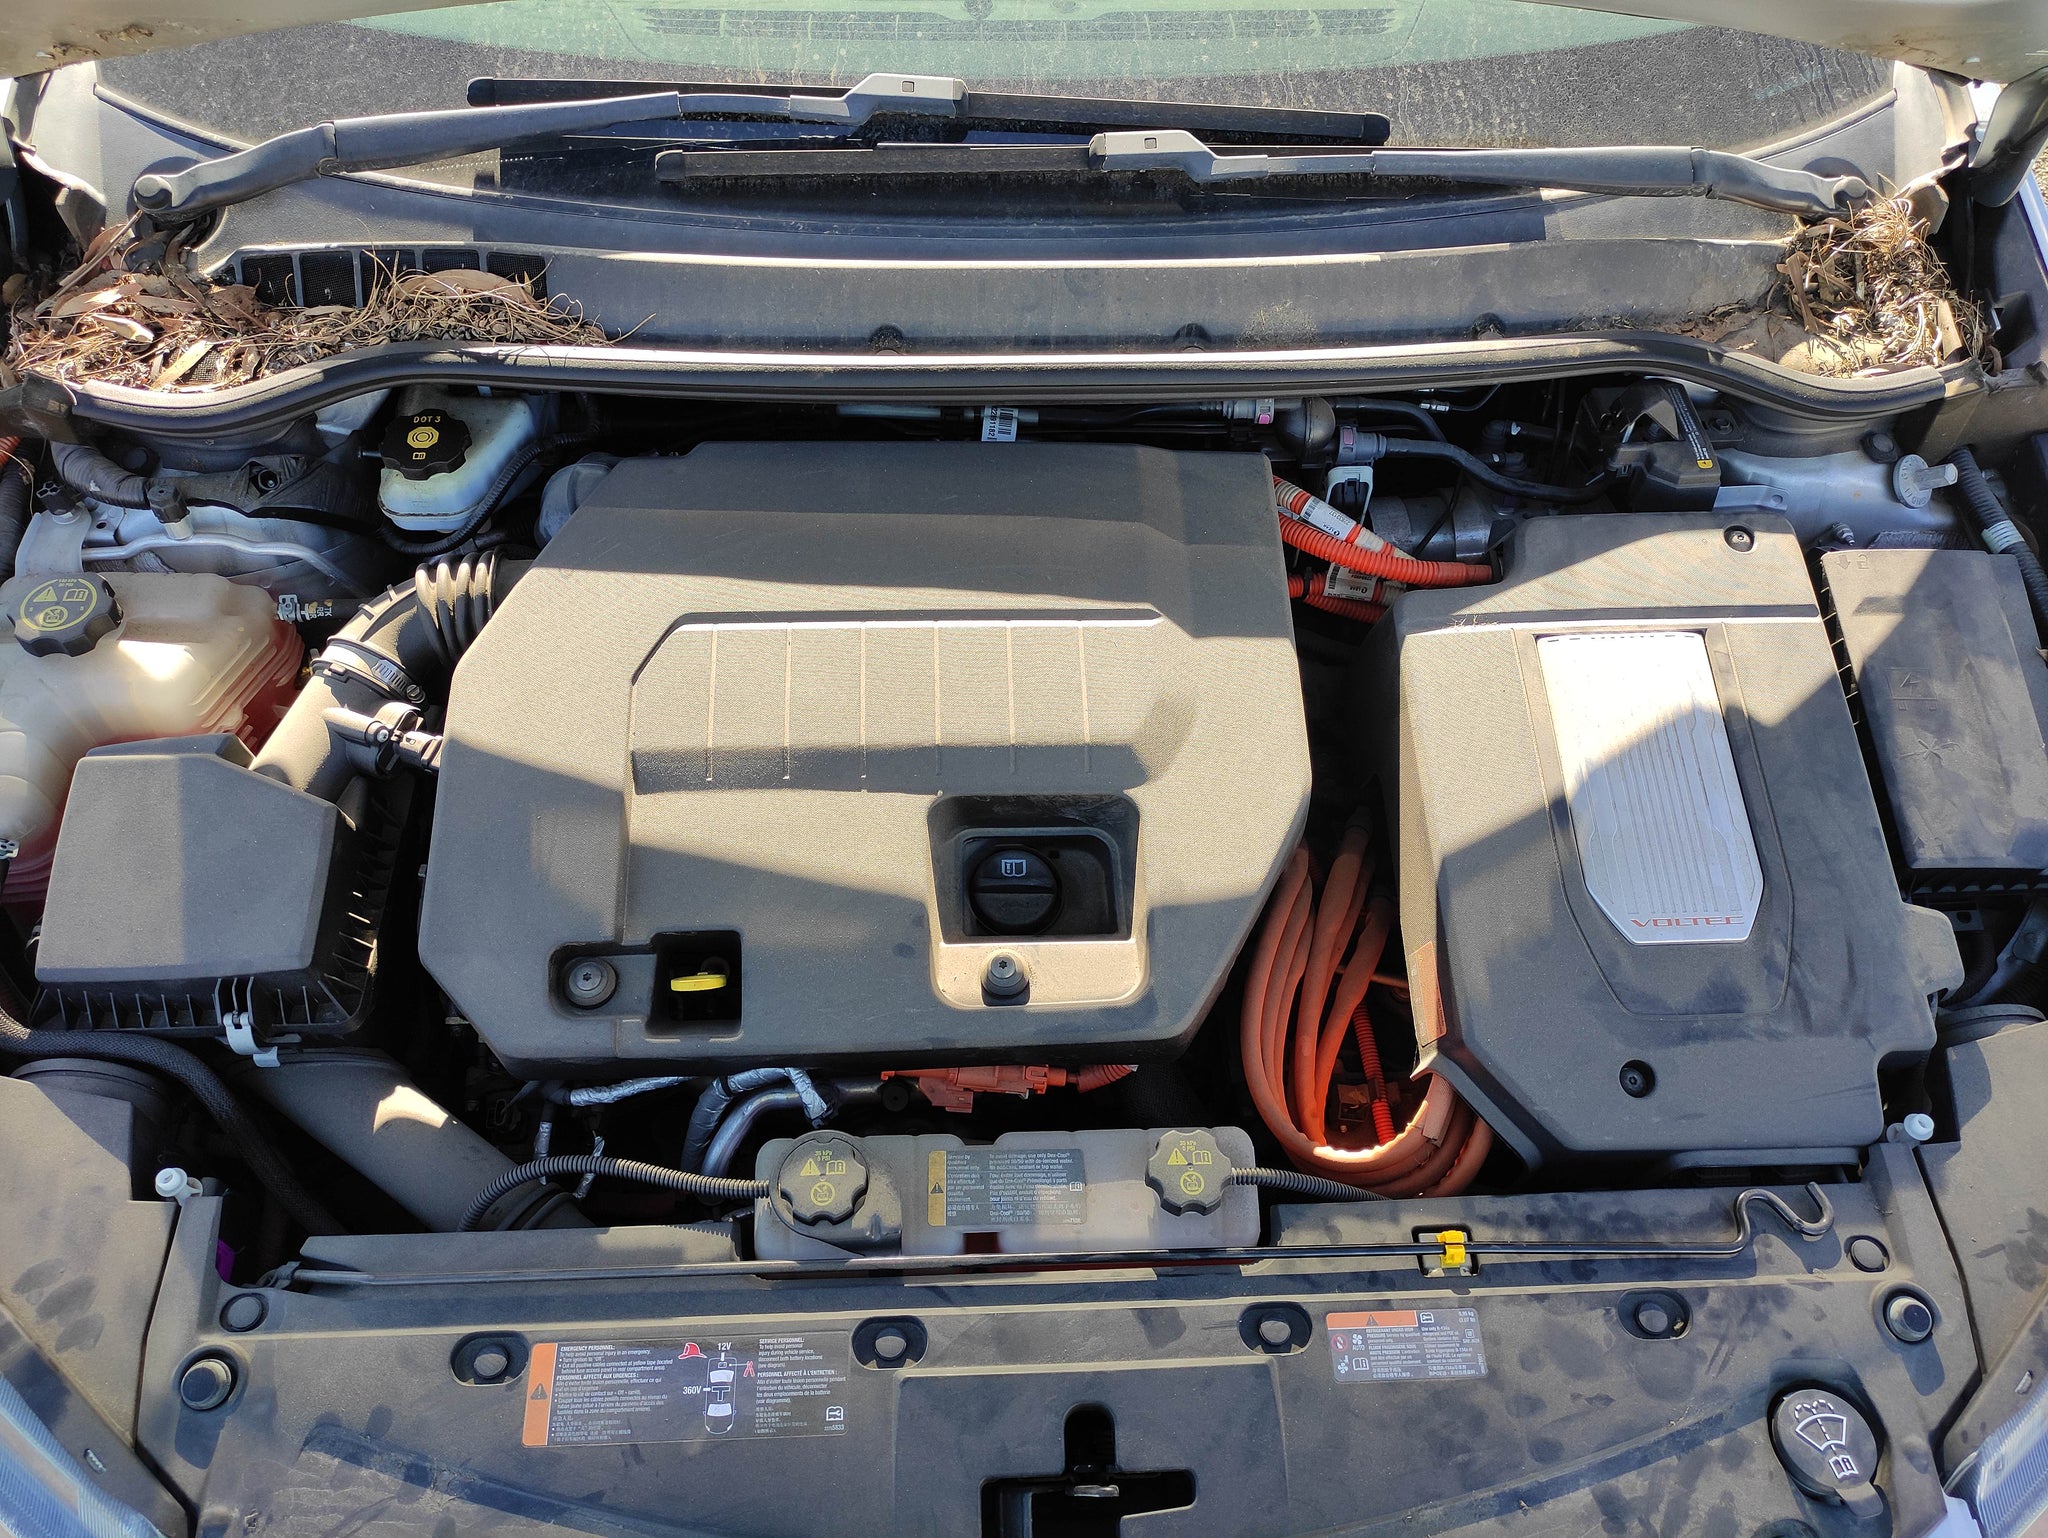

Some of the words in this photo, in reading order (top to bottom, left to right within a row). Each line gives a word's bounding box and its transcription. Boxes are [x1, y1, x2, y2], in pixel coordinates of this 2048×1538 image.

[317, 607, 324, 616] RR
[325, 607, 332, 616] TK
[1630, 916, 1744, 928] VOLTEC
[718, 1342, 731, 1351] 12V
[682, 1386, 701, 1394] 360V
